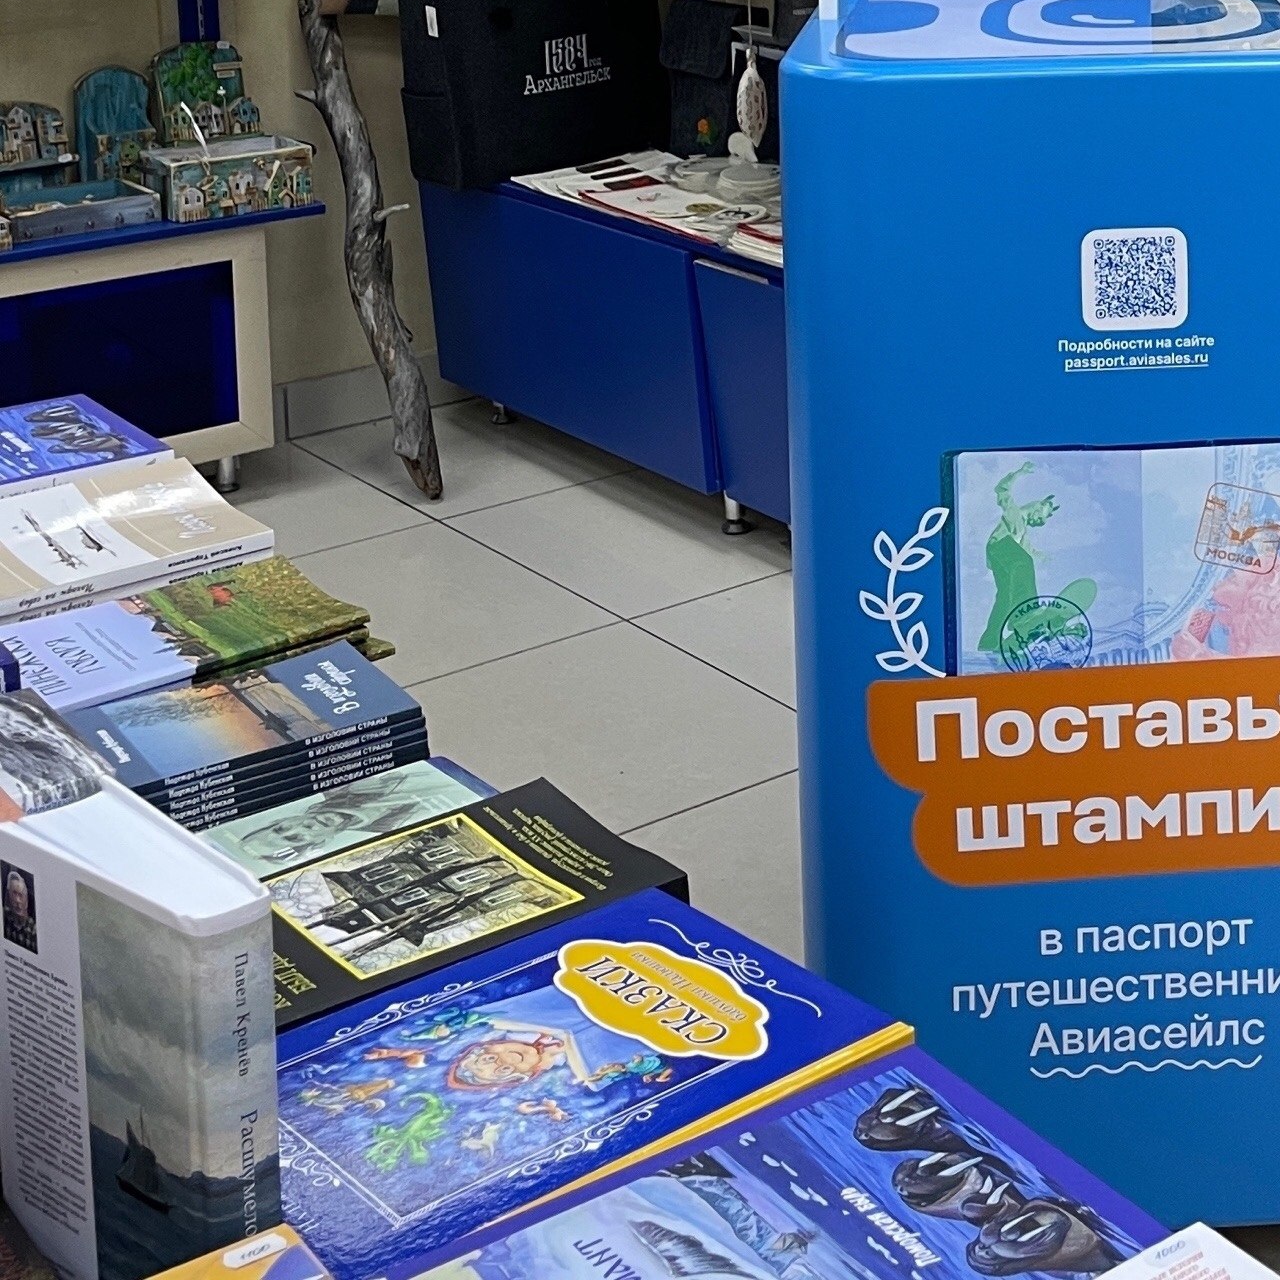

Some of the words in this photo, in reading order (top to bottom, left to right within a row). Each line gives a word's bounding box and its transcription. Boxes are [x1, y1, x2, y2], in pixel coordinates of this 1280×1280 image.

[544, 33, 589, 75] 1584
[1057, 339, 1153, 354] Подробности
[1155, 339, 1172, 349] на
[1174, 334, 1215, 347] сайте
[1064, 353, 1209, 370] passport.aviasales.ru
[1204, 546, 1263, 569] МОСКВА
[1018, 600, 1062, 617] КАЗАНЬ
[357, 717, 388, 732] СТРАНЫ
[361, 729, 391, 743] СТРАНЫ
[363, 741, 393, 756] СТРАНЫ
[363, 753, 393, 767] СТРАНЫ
[365, 761, 395, 776] СТРАНЫ
[1040, 929, 1062, 955] в
[1077, 919, 1253, 956] паспорт
[234, 952, 248, 1008] Павел
[576, 956, 728, 1044] СКАЗКИ
[233, 1012, 251, 1077] Кренёв
[1030, 1013, 1265, 1057] Авиасейлс
[866, 1211, 942, 1267] Поморская
